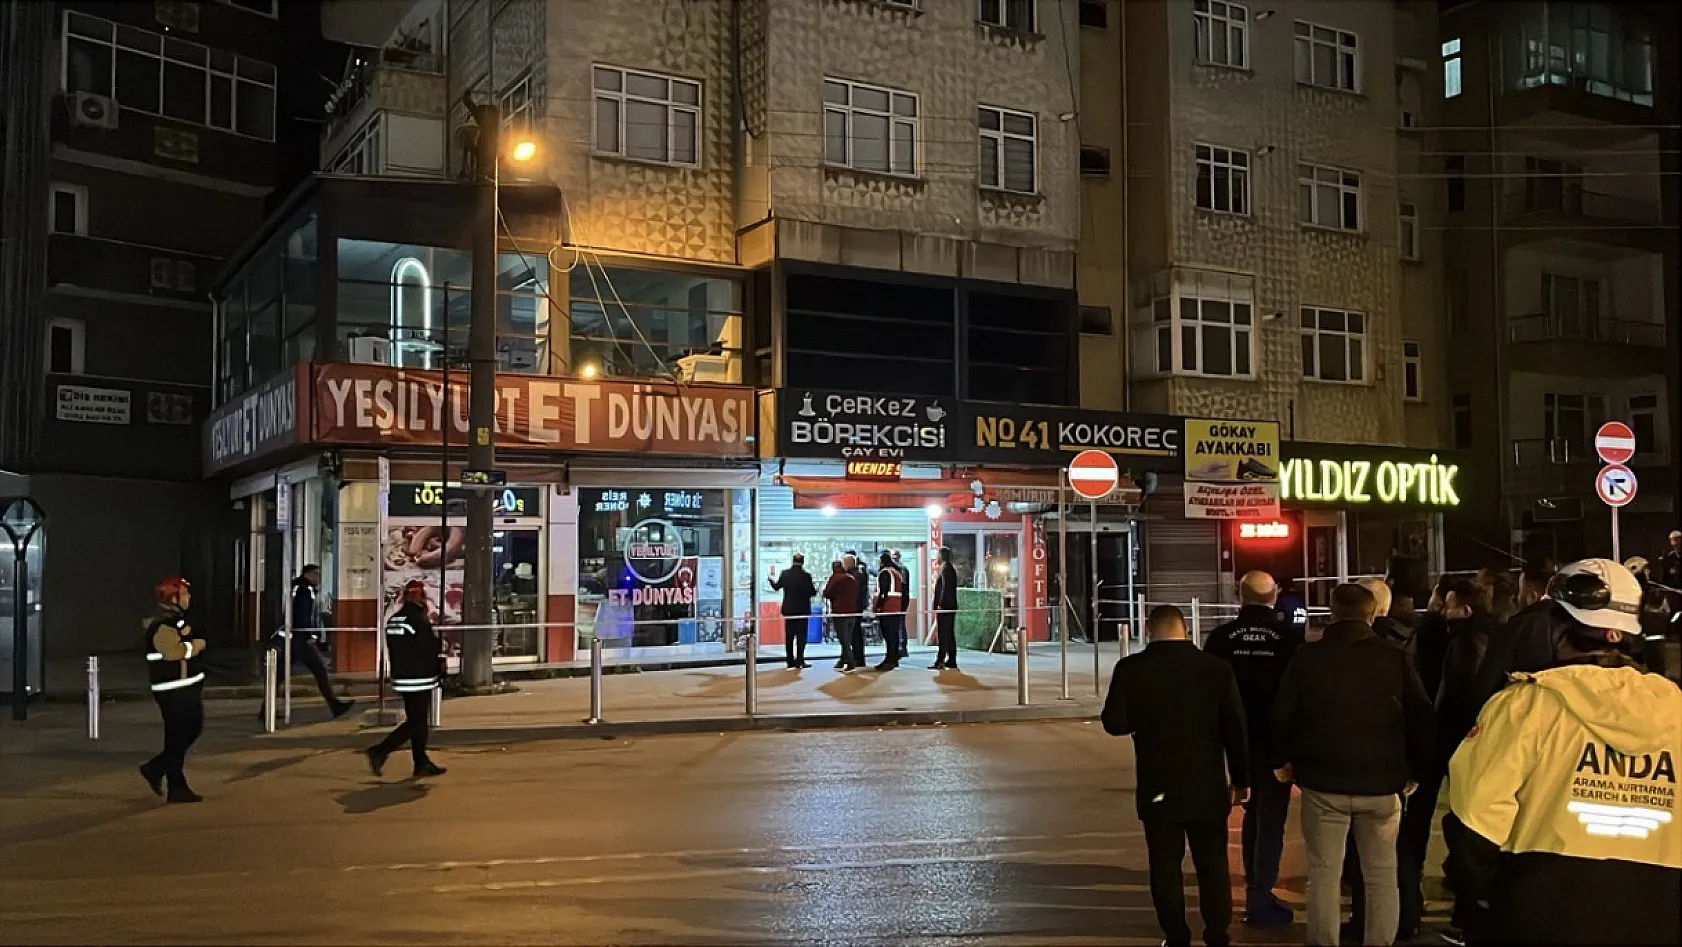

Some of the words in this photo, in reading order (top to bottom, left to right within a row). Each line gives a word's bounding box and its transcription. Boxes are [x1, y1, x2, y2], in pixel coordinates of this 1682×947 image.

[326, 371, 520, 436] YEŞİLYUT
[528, 381, 601, 444] ET
[608, 384, 747, 444] DÜNYASI
[1209, 422, 1256, 438] GÖKAY
[841, 447, 873, 457] ÇAY
[1196, 440, 1272, 456] AYAKKABI
[1279, 458, 1371, 502] YILDIZ
[1376, 453, 1460, 505] OPTİK
[608, 588, 629, 607] ET
[1576, 742, 1676, 783] ANDA
[1572, 787, 1619, 802] SEARCH
[1621, 793, 1628, 802] &
[1631, 794, 1673, 808] RESCUE
[1573, 777, 1615, 791] ARAMA
[1618, 782, 1675, 798] KURTARMA
